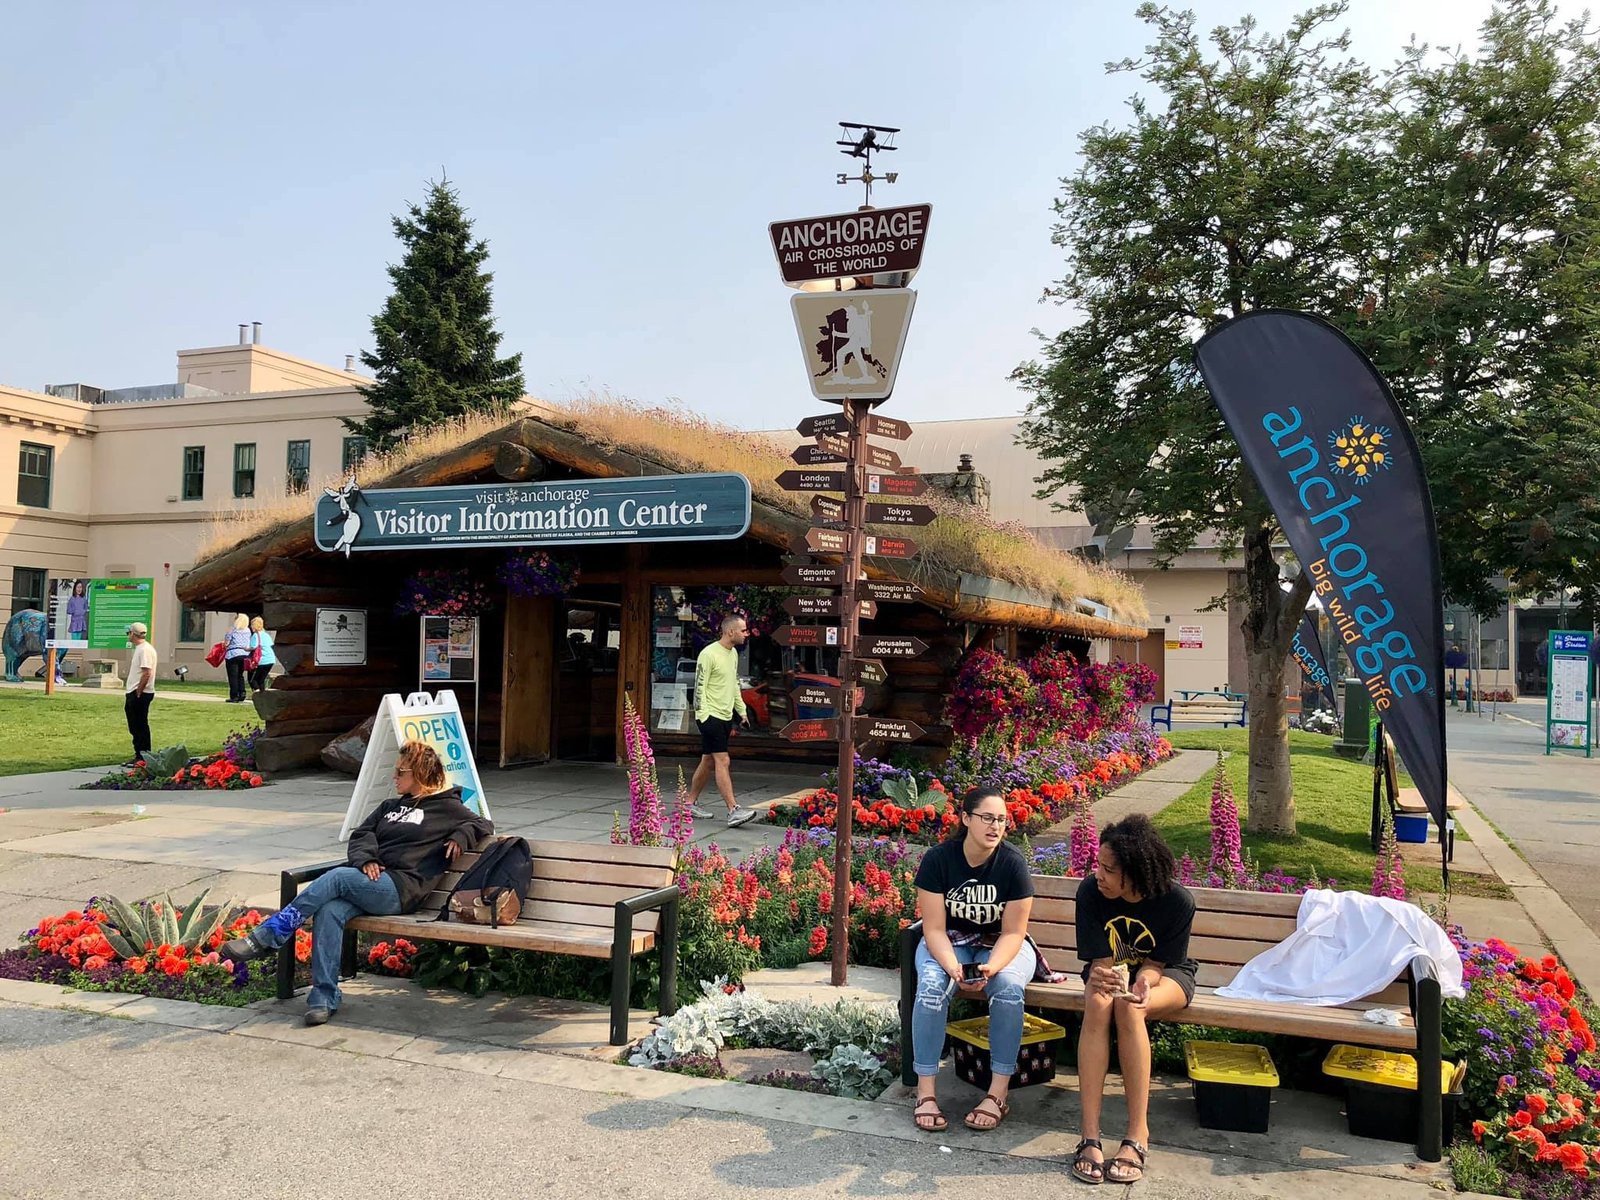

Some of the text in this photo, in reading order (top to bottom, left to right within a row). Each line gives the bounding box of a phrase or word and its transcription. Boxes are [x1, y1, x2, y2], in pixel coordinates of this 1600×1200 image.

[885, 172, 898, 184] W
[779, 210, 923, 250] ANCHORAGE
[784, 238, 918, 263] AIR CROSSROADS OF
[814, 256, 887, 275] THE WORLD
[814, 418, 836, 427] Seattle
[878, 419, 896, 429] Homer
[800, 474, 830, 482] London
[475, 487, 590, 504] visit anchorage
[374, 499, 708, 535] Visitor Information Center
[887, 507, 911, 516] Tokyo
[818, 532, 843, 542] Fairbanks
[882, 539, 905, 548] Darwin
[1263, 406, 1427, 698] anchorage
[798, 568, 835, 576] Edmonton
[868, 584, 919, 593] Washington D.C.
[790, 628, 818, 637] Whitby
[1309, 558, 1393, 712] big wild life
[1292, 632, 1330, 687] horage
[806, 688, 825, 696] Boston
[404, 718, 459, 742] OPEN
[875, 722, 906, 731] Frankfurt
[963, 884, 997, 903] WILD
